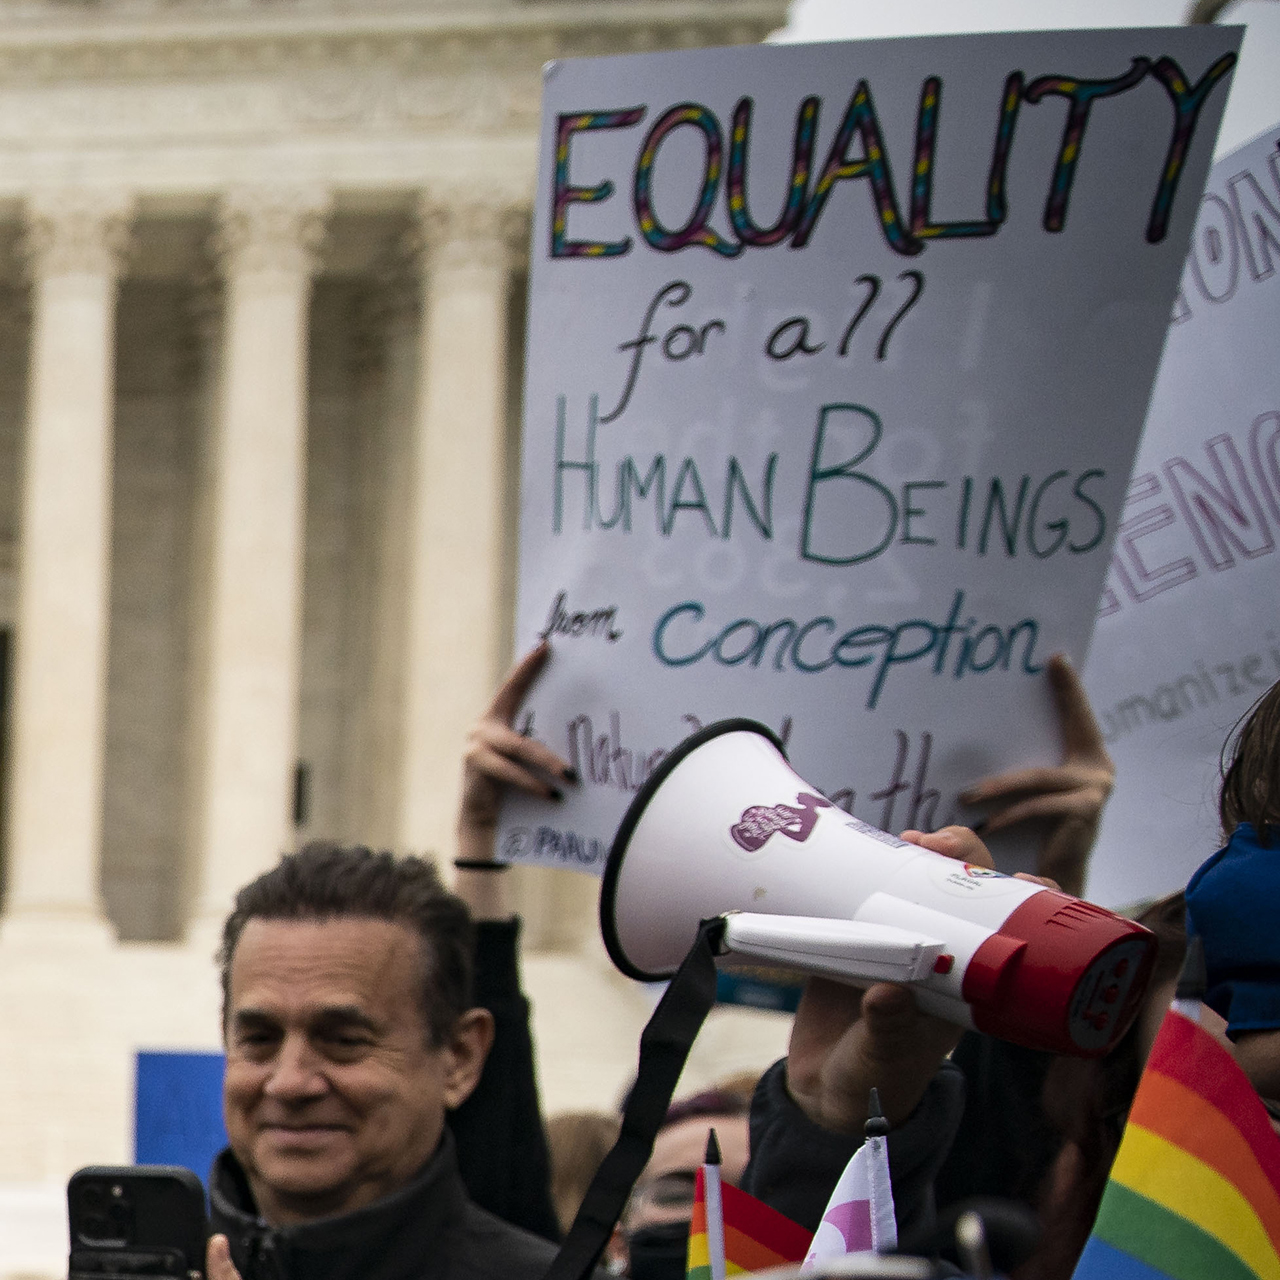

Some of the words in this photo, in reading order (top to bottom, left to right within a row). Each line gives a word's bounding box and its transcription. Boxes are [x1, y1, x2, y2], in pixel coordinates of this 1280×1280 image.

[550, 52, 1238, 258] EQUALITY
[1168, 146, 1280, 325] ON
[600, 280, 725, 424] for
